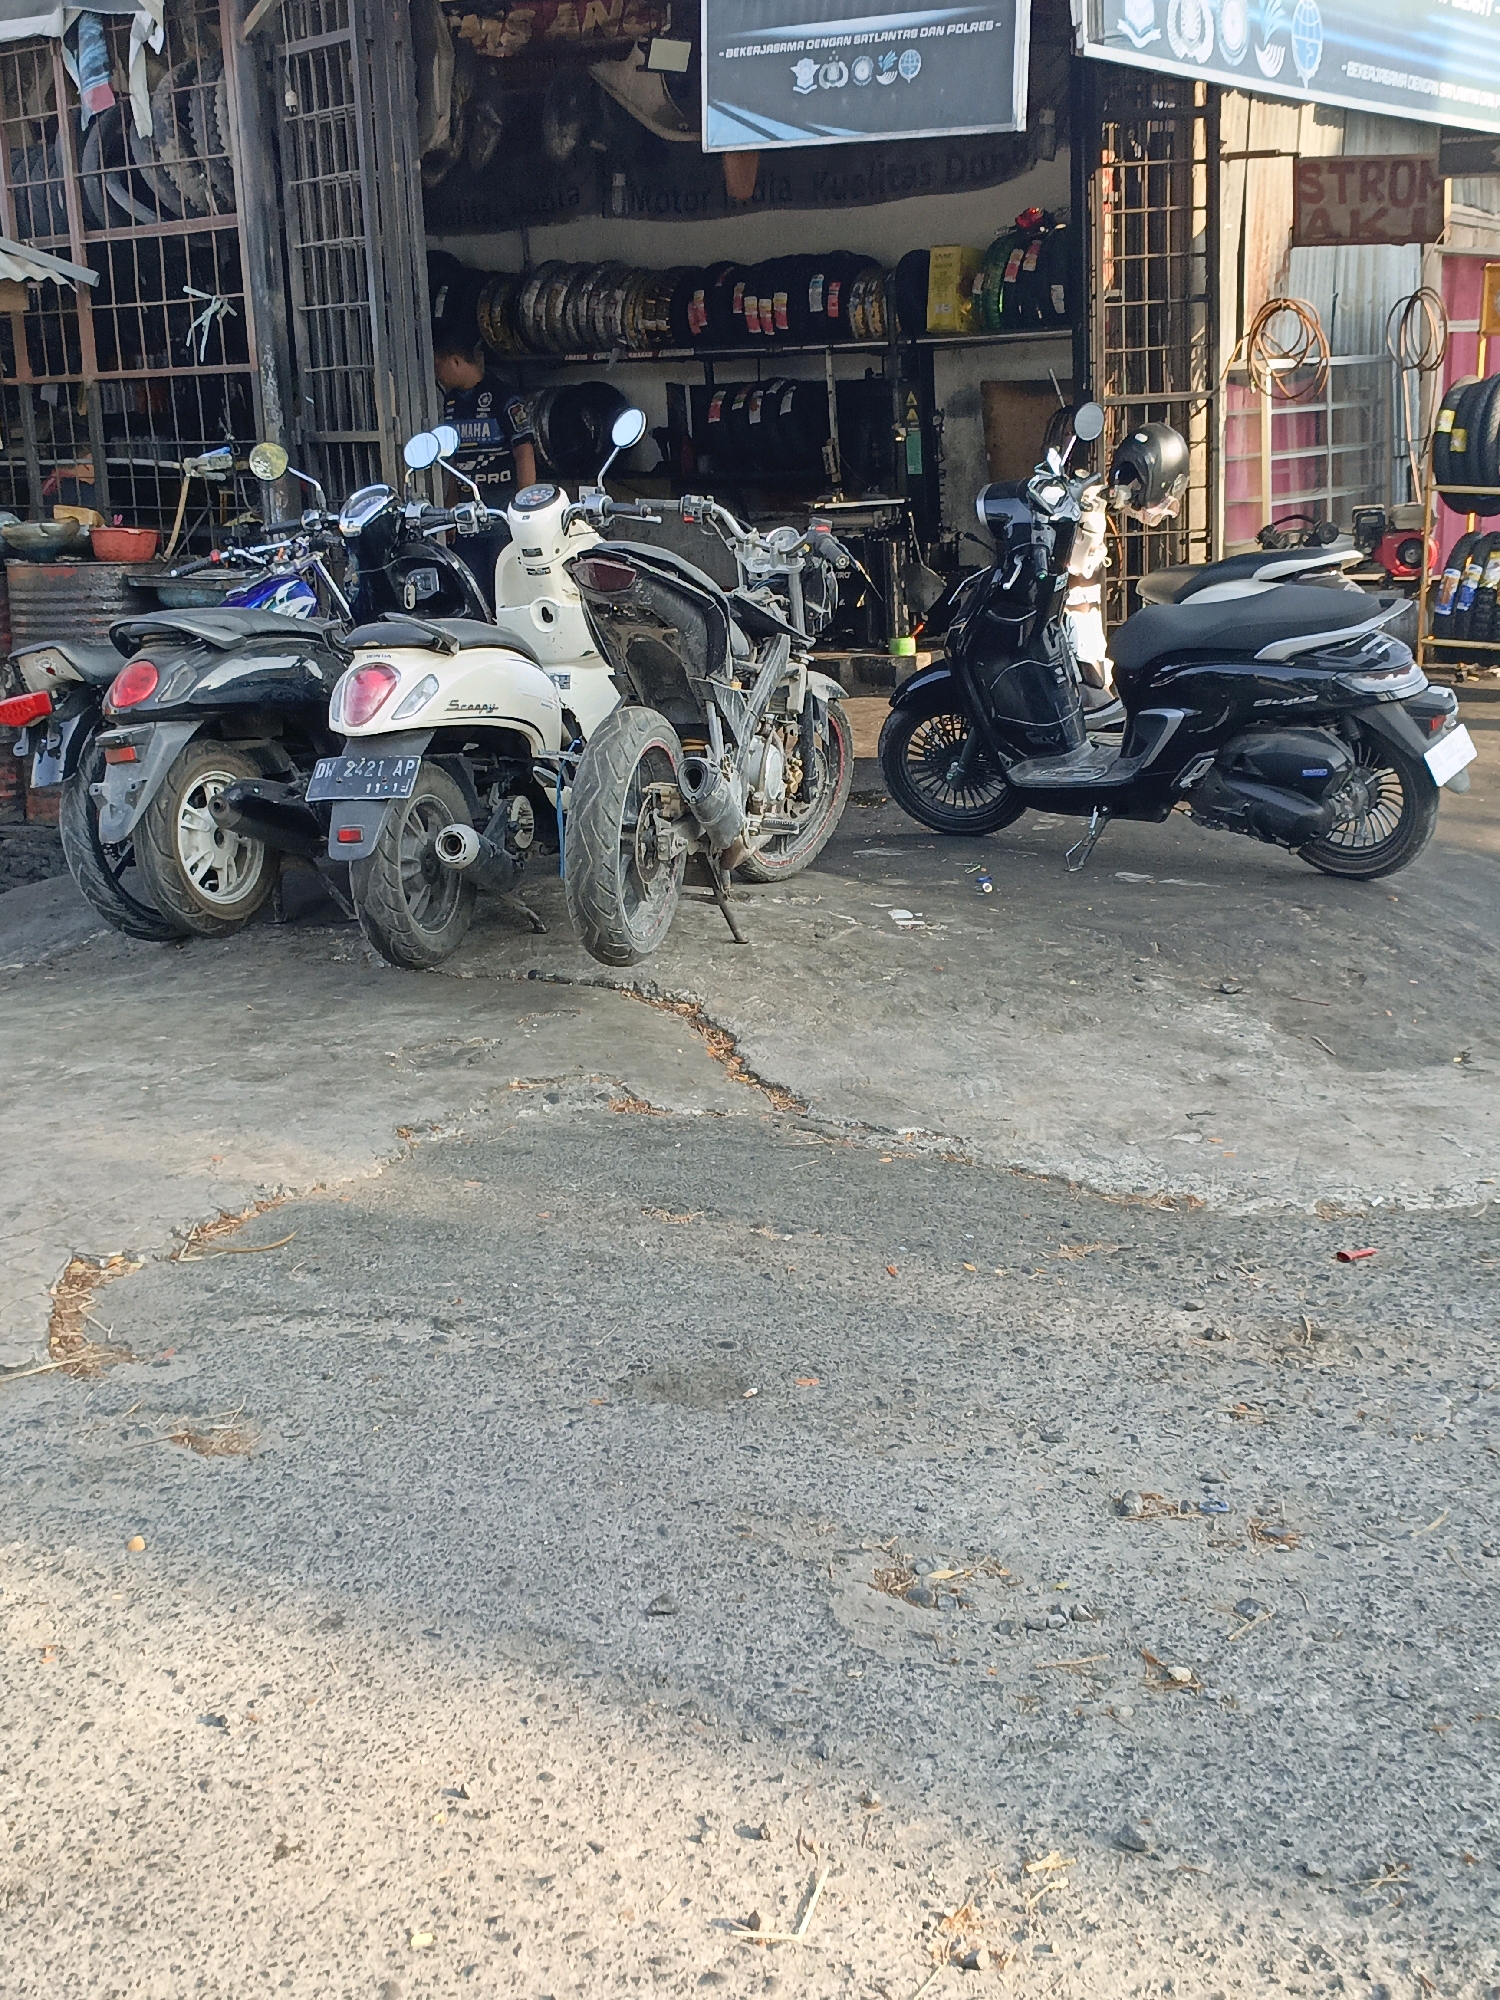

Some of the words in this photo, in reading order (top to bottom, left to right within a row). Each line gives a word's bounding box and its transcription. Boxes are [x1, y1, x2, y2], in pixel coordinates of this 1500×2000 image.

[725, 41, 804, 59] BEKERJASAMA
[806, 35, 852, 51] DENGAN
[854, 28, 918, 45] SATLANTAS
[920, 25, 945, 38] DAN
[946, 20, 994, 36] POLRES
[629, 181, 711, 214] Motor
[812, 155, 932, 202] Kualitas
[1303, 207, 1428, 239] AKI
[444, 699, 499, 714] Scoopy
[343, 758, 385, 777] 2421
[393, 760, 415, 776] AP
